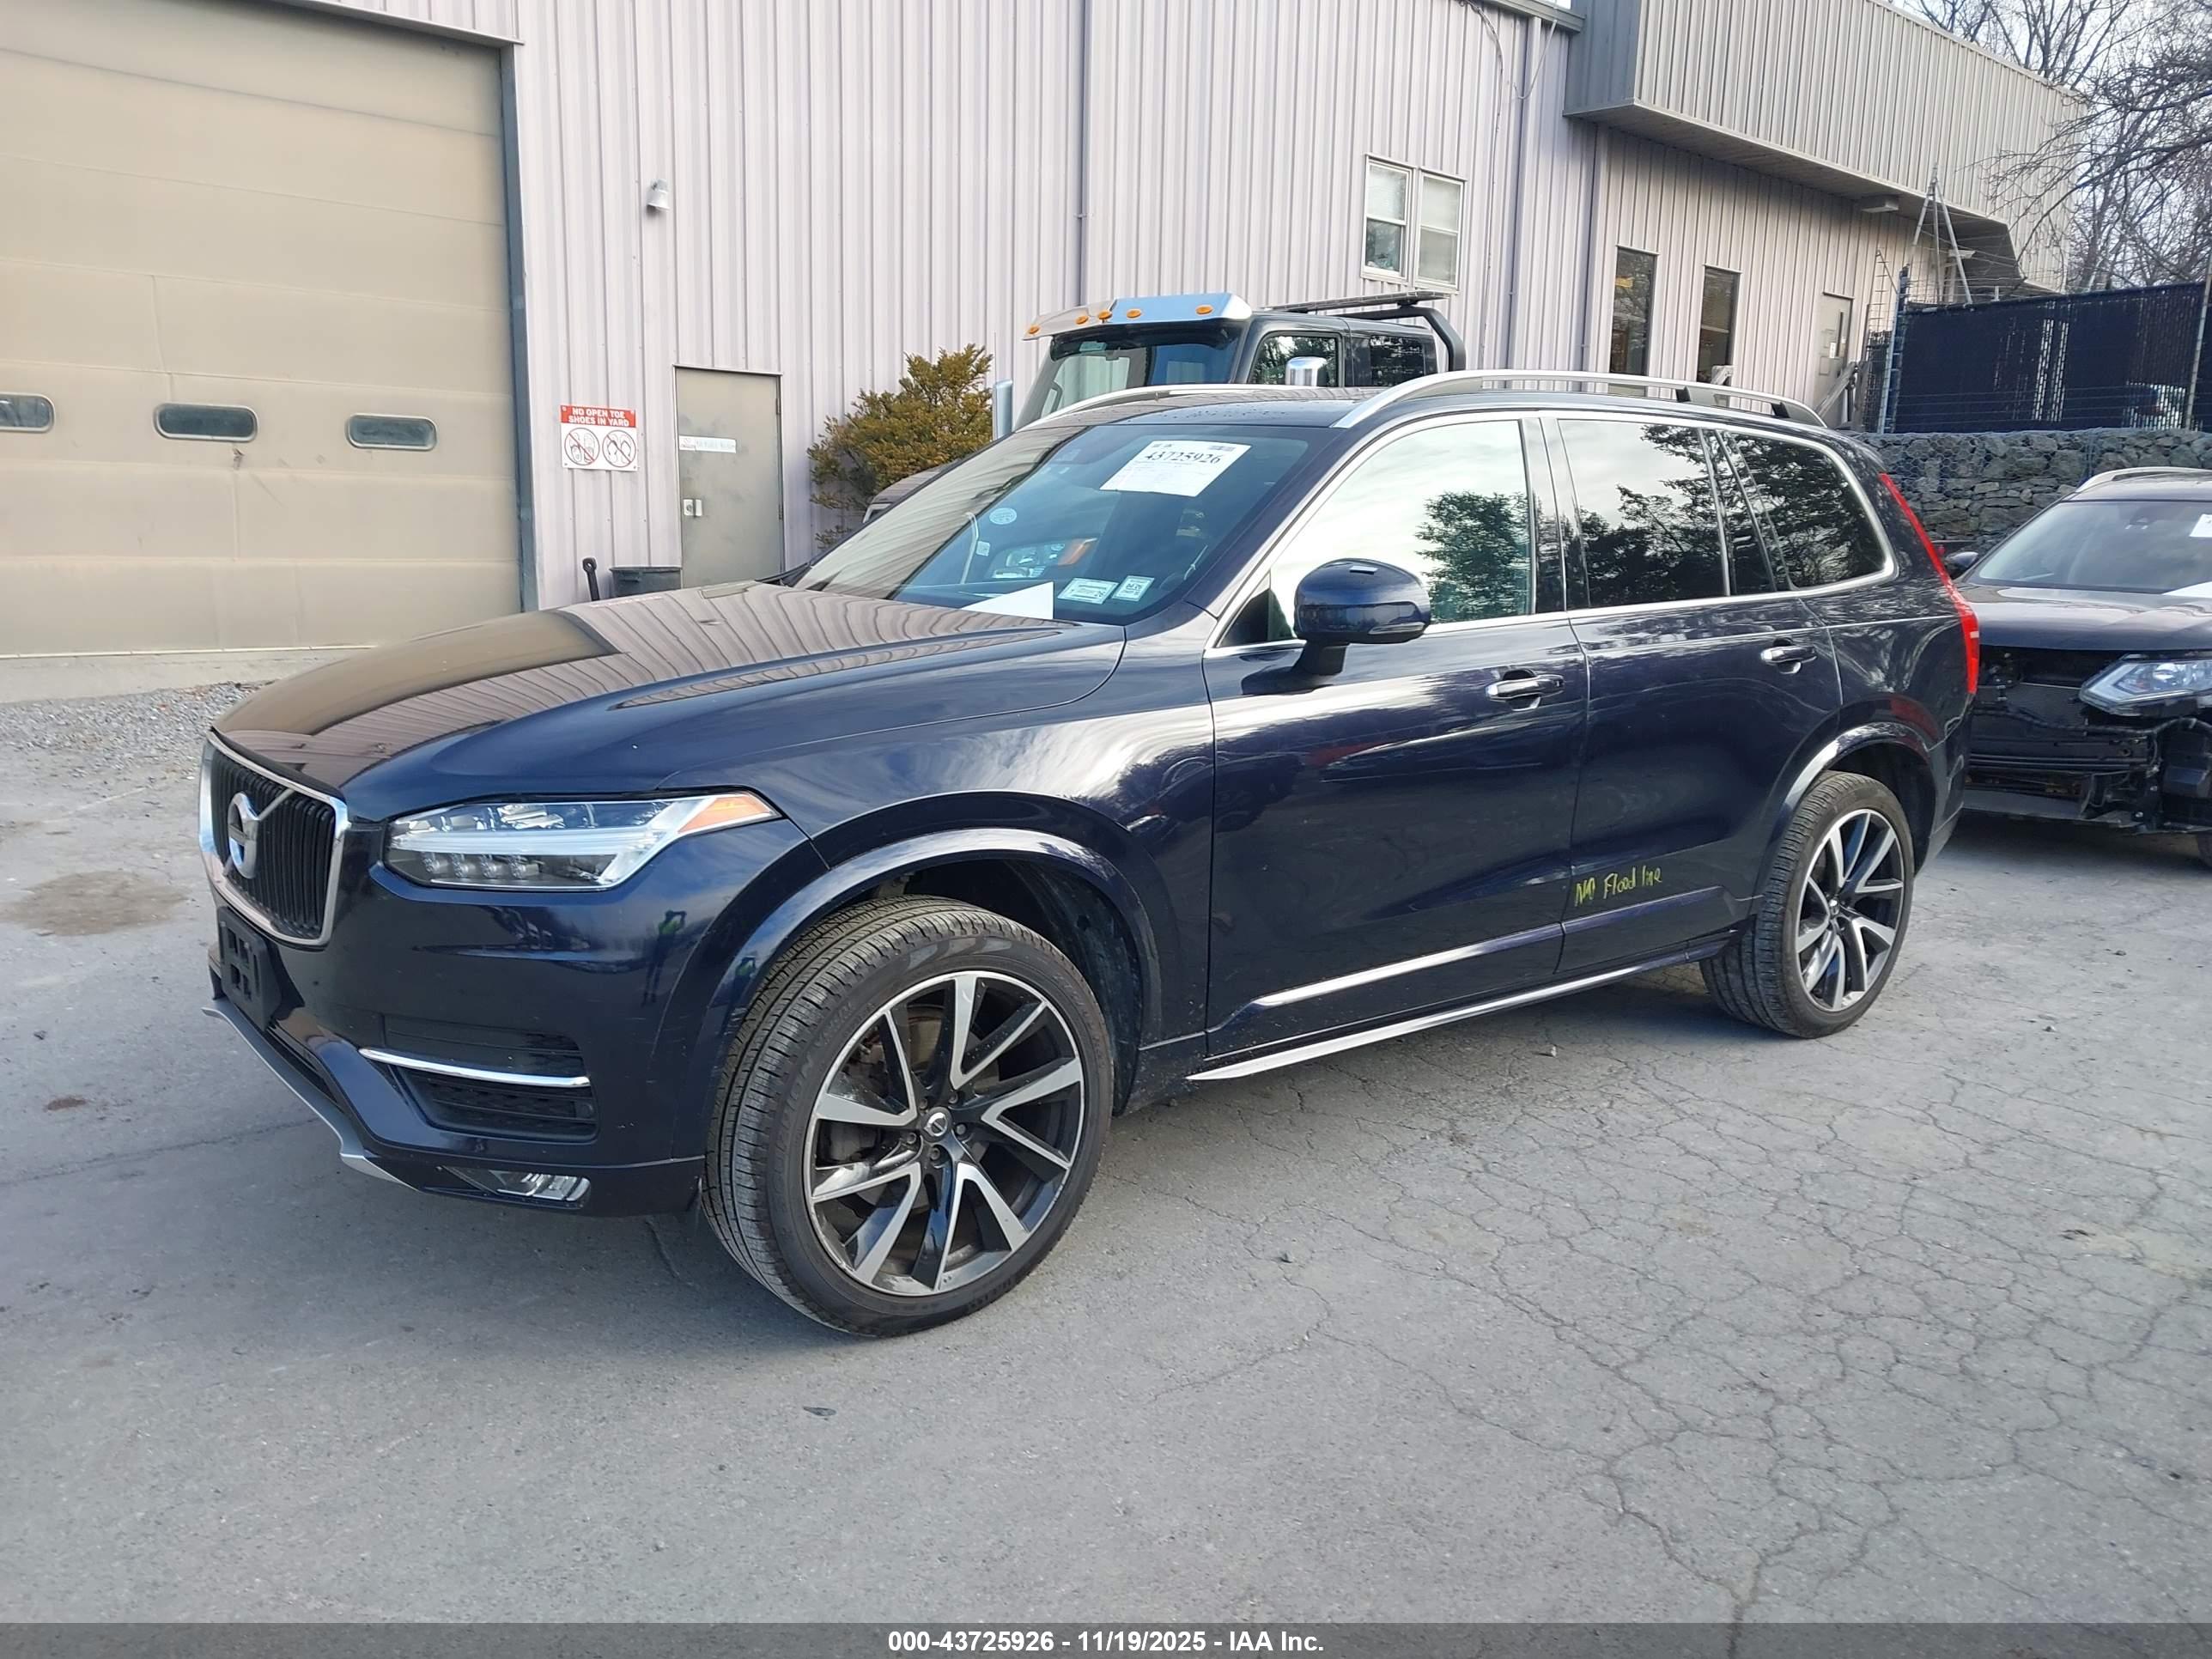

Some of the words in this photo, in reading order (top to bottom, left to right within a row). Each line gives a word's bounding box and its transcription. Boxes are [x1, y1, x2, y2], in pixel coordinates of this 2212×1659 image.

[572, 407, 585, 416] NO
[586, 408, 608, 417] OPEN
[611, 410, 625, 418] TOE
[568, 416, 595, 425] SHOES
[598, 416, 606, 426] IN
[609, 417, 629, 427] YARD
[1145, 451, 1223, 465] 43725926
